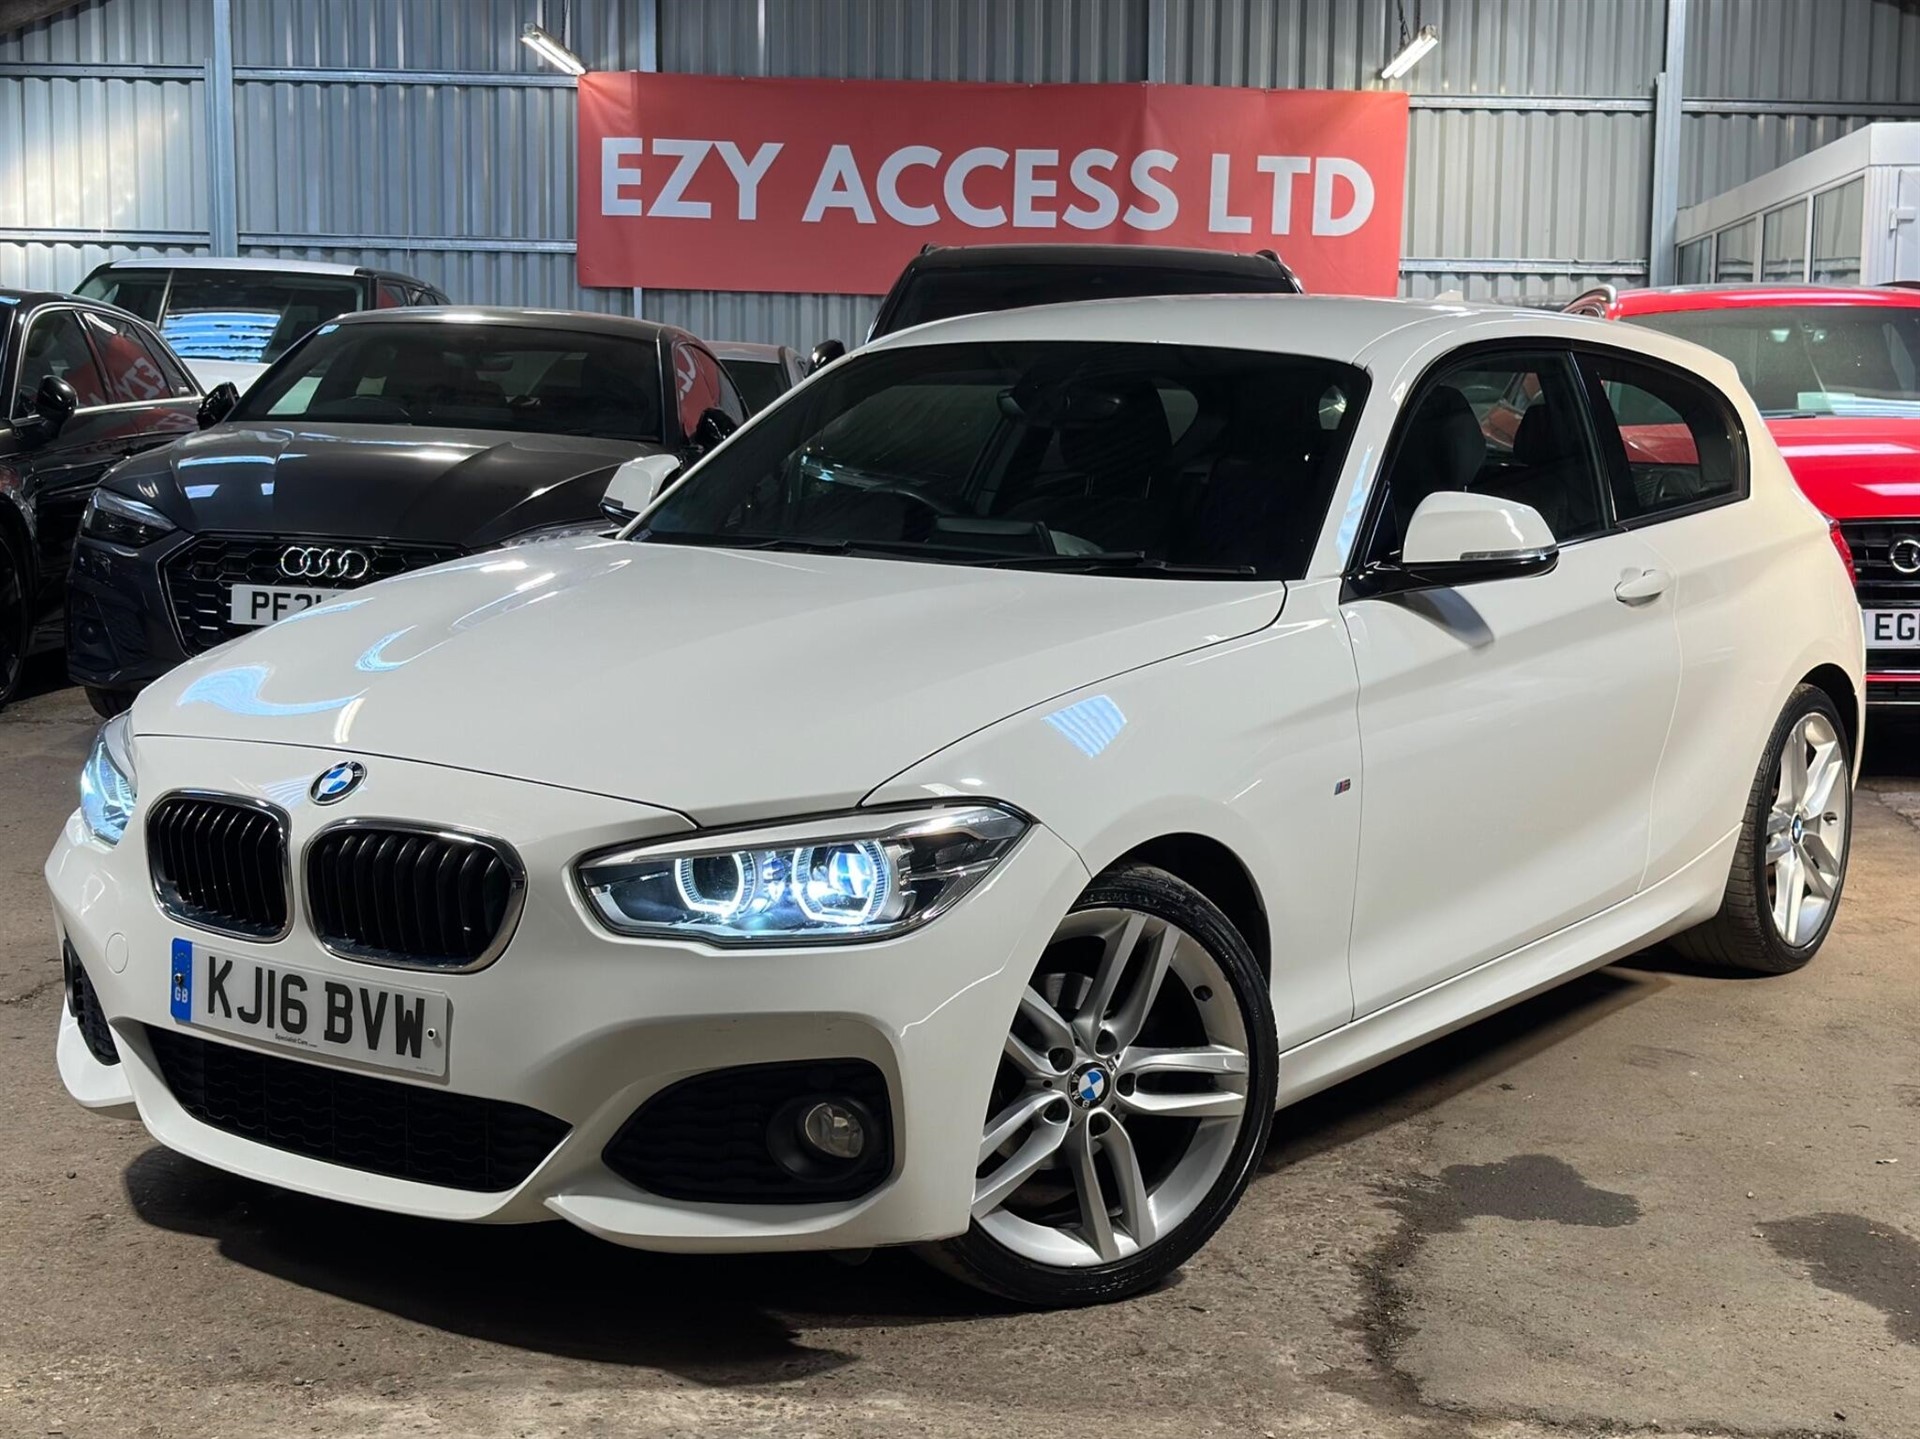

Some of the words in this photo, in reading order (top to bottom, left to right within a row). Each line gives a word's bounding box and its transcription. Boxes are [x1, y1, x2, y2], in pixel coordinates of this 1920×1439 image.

[601, 137, 785, 221] EZY
[801, 144, 1180, 231] ACCESS
[1208, 153, 1376, 237] LTD
[1874, 613, 1920, 641] EG
[174, 986, 188, 1004] GB
[207, 955, 308, 1035] KJ16
[323, 980, 425, 1059] BVW
